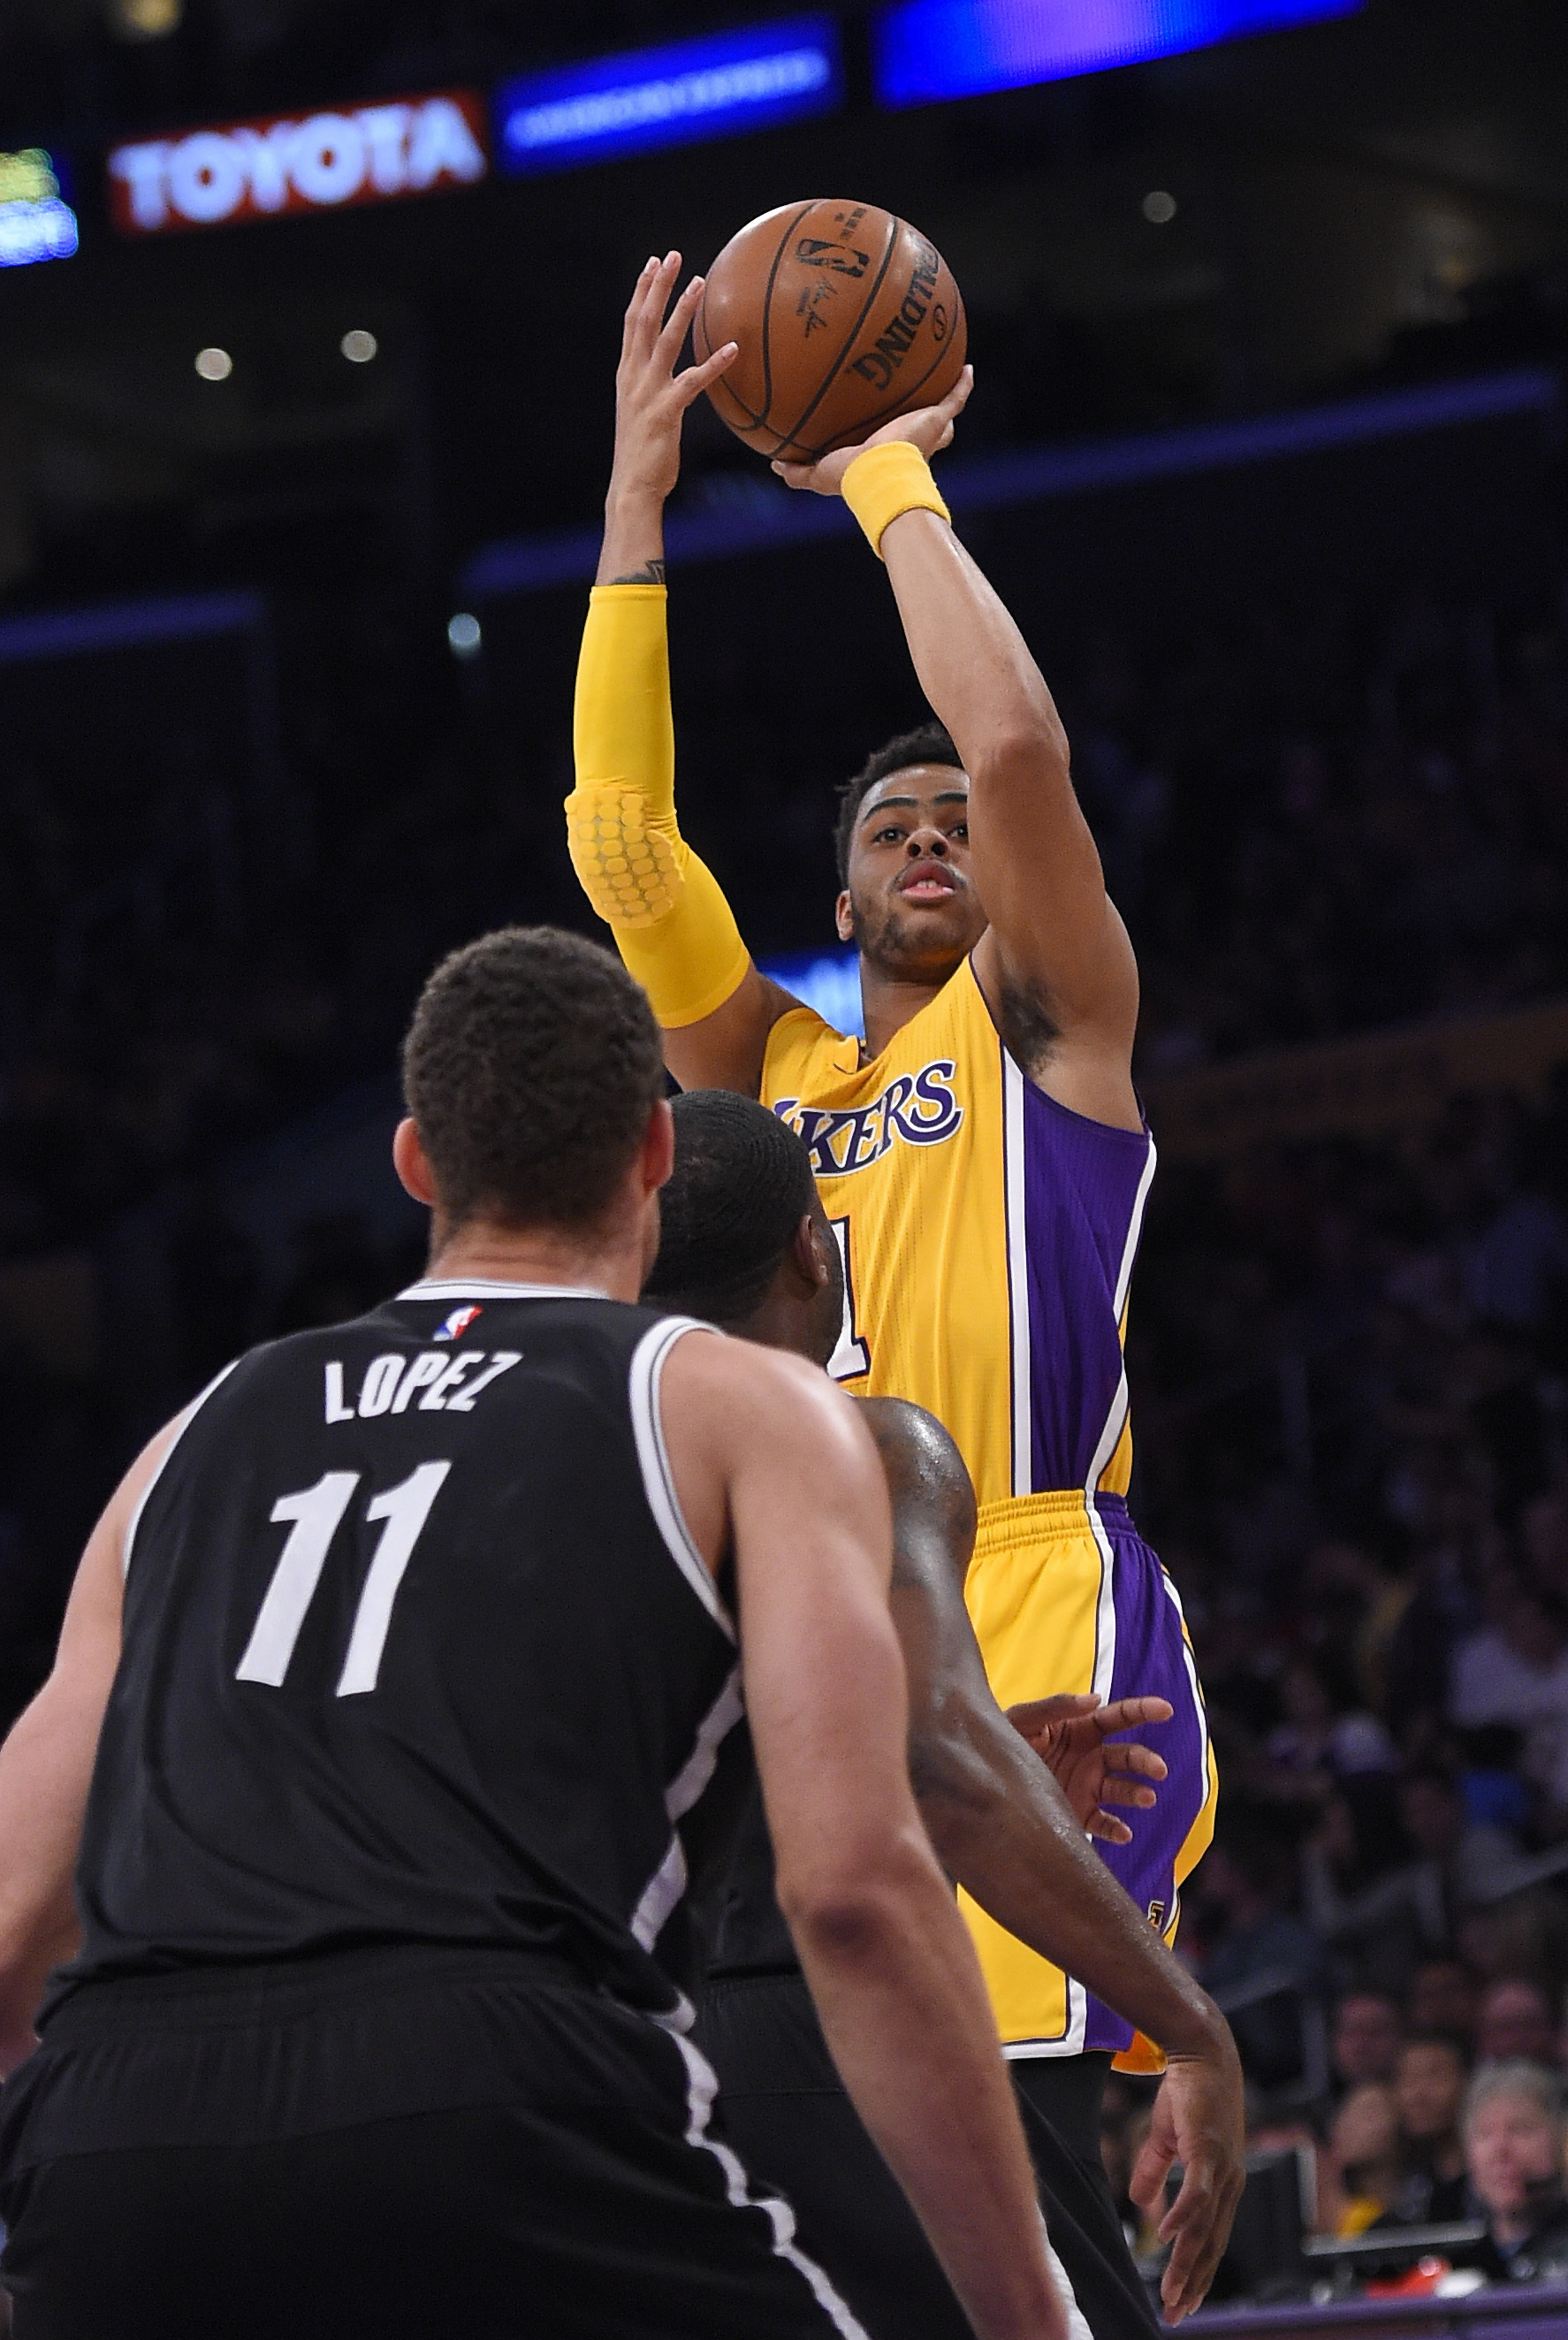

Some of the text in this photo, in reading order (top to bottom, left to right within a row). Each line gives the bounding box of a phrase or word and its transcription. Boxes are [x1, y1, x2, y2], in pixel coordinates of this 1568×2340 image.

[109, 97, 486, 230] TOYOTA
[773, 1059, 964, 1178] KERS
[323, 1350, 523, 1424] LOPEZ
[235, 1459, 453, 1698] 11
